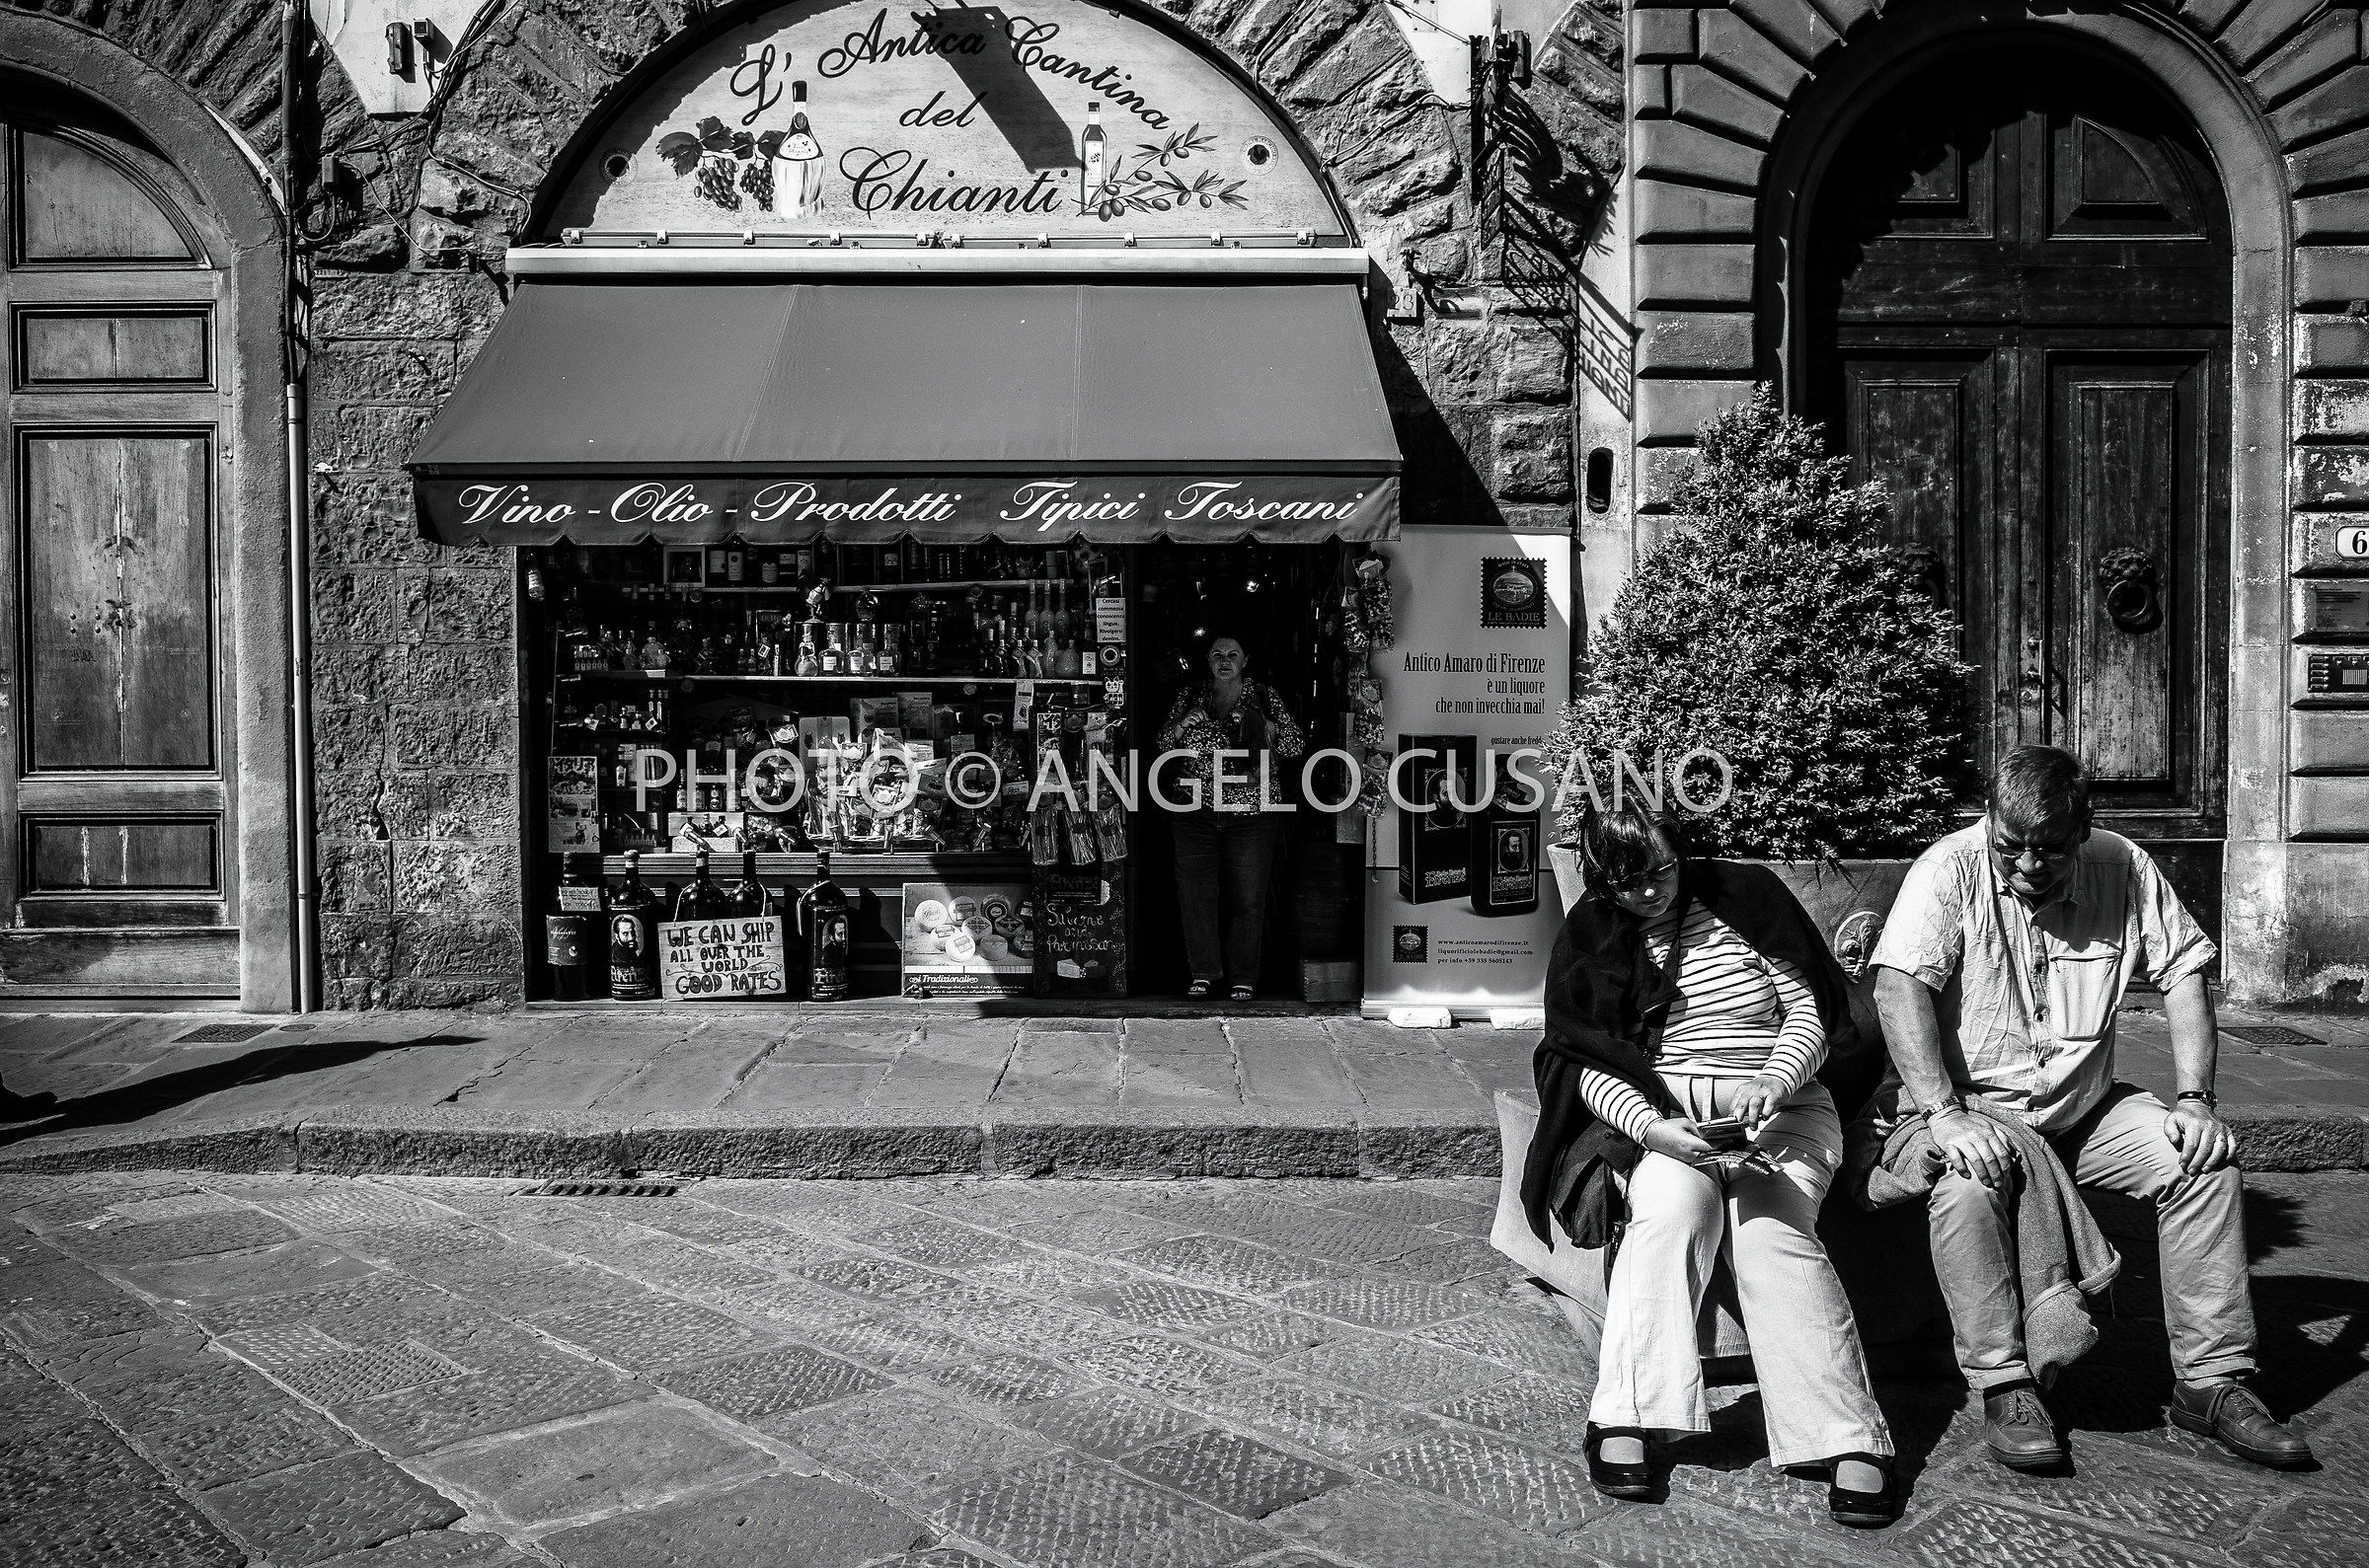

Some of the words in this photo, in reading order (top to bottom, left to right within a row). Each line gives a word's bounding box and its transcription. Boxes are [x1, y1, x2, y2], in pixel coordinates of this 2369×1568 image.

[730, 43, 792, 126] L'
[817, 7, 986, 79] Antica
[1005, 16, 1172, 130] Cantina
[899, 90, 987, 129] del
[839, 146, 1070, 221] Chianti
[459, 485, 575, 524] Vino
[611, 483, 713, 523] Olio
[751, 482, 961, 523] Prodotti
[1000, 482, 1145, 531] Tipici
[1165, 482, 1359, 522] Toscani
[2352, 531, 2368, 556] 6
[1488, 611, 1502, 622] LE
[1505, 611, 1540, 622] BADIE
[1403, 651, 1441, 673] Antico
[1443, 652, 1484, 673] Amaro
[1486, 652, 1497, 673] di
[1499, 652, 1546, 674] Firenze
[1487, 678, 1493, 694] è
[1494, 680, 1508, 694] un
[1509, 677, 1546, 697] liquore
[1435, 696, 1453, 713] che
[1454, 701, 1474, 713] non
[1476, 697, 1522, 714] invecchia
[1523, 698, 1546, 714] mai!
[1511, 735, 1528, 745] anche
[667, 927, 694, 947] WE
[699, 924, 736, 944] CAN
[741, 922, 775, 944] SHIP
[670, 948, 694, 963] ALL
[733, 944, 765, 959] THE
[701, 957, 749, 973] WORLD
[675, 975, 723, 995] GOOD
[730, 970, 782, 992] RATES
[922, 974, 971, 984] Tradizionali
